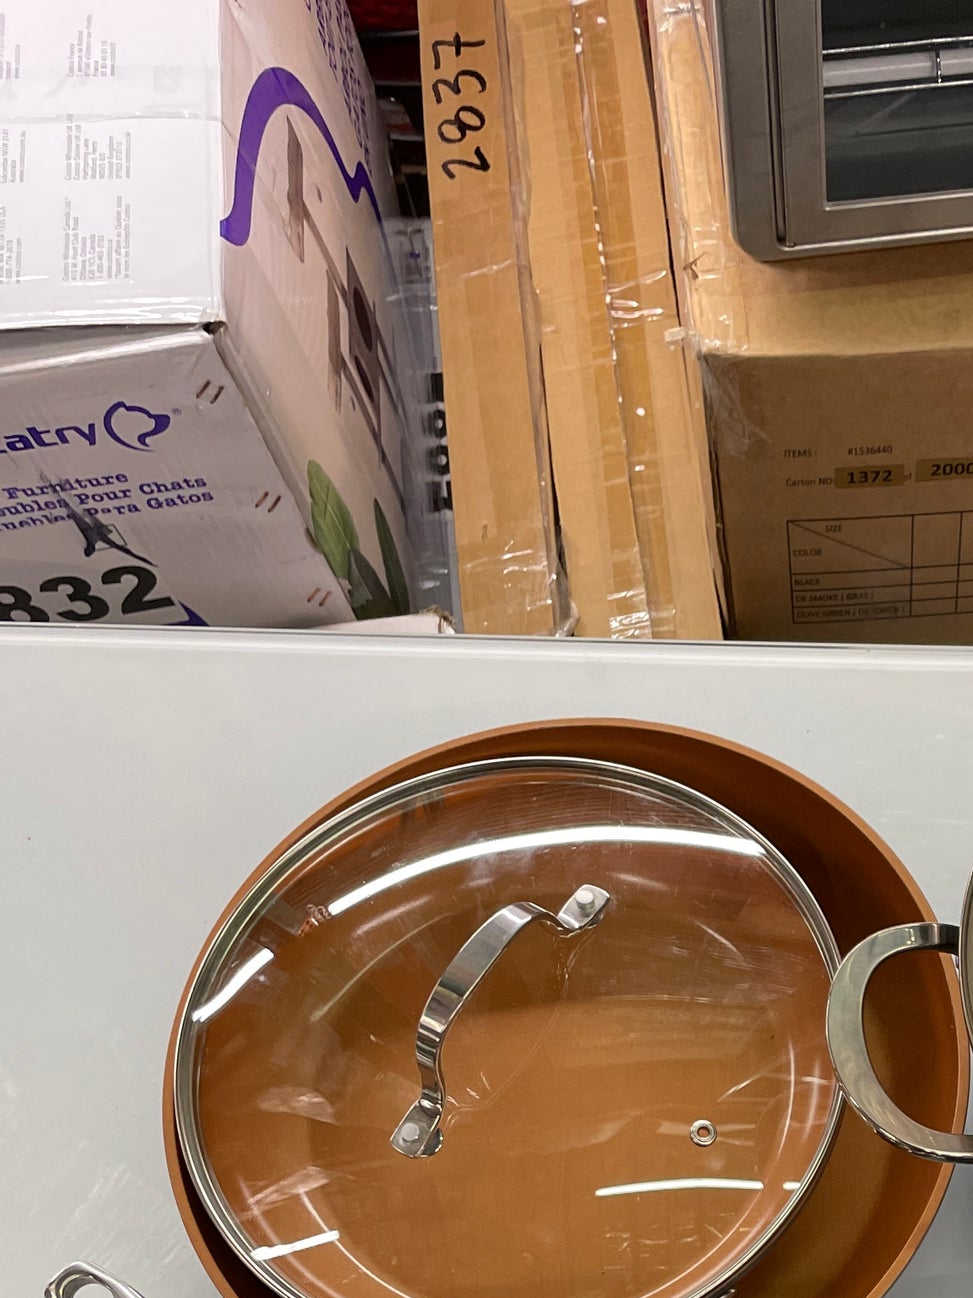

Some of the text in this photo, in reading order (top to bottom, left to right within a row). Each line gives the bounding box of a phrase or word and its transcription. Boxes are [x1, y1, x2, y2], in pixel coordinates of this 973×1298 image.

[432, 31, 491, 180] 2837
[0, 423, 97, 453] atry
[846, 469, 894, 484] 1372
[74, 488, 132, 505] Pour
[139, 477, 207, 495] Chats
[146, 491, 215, 509] Gatos
